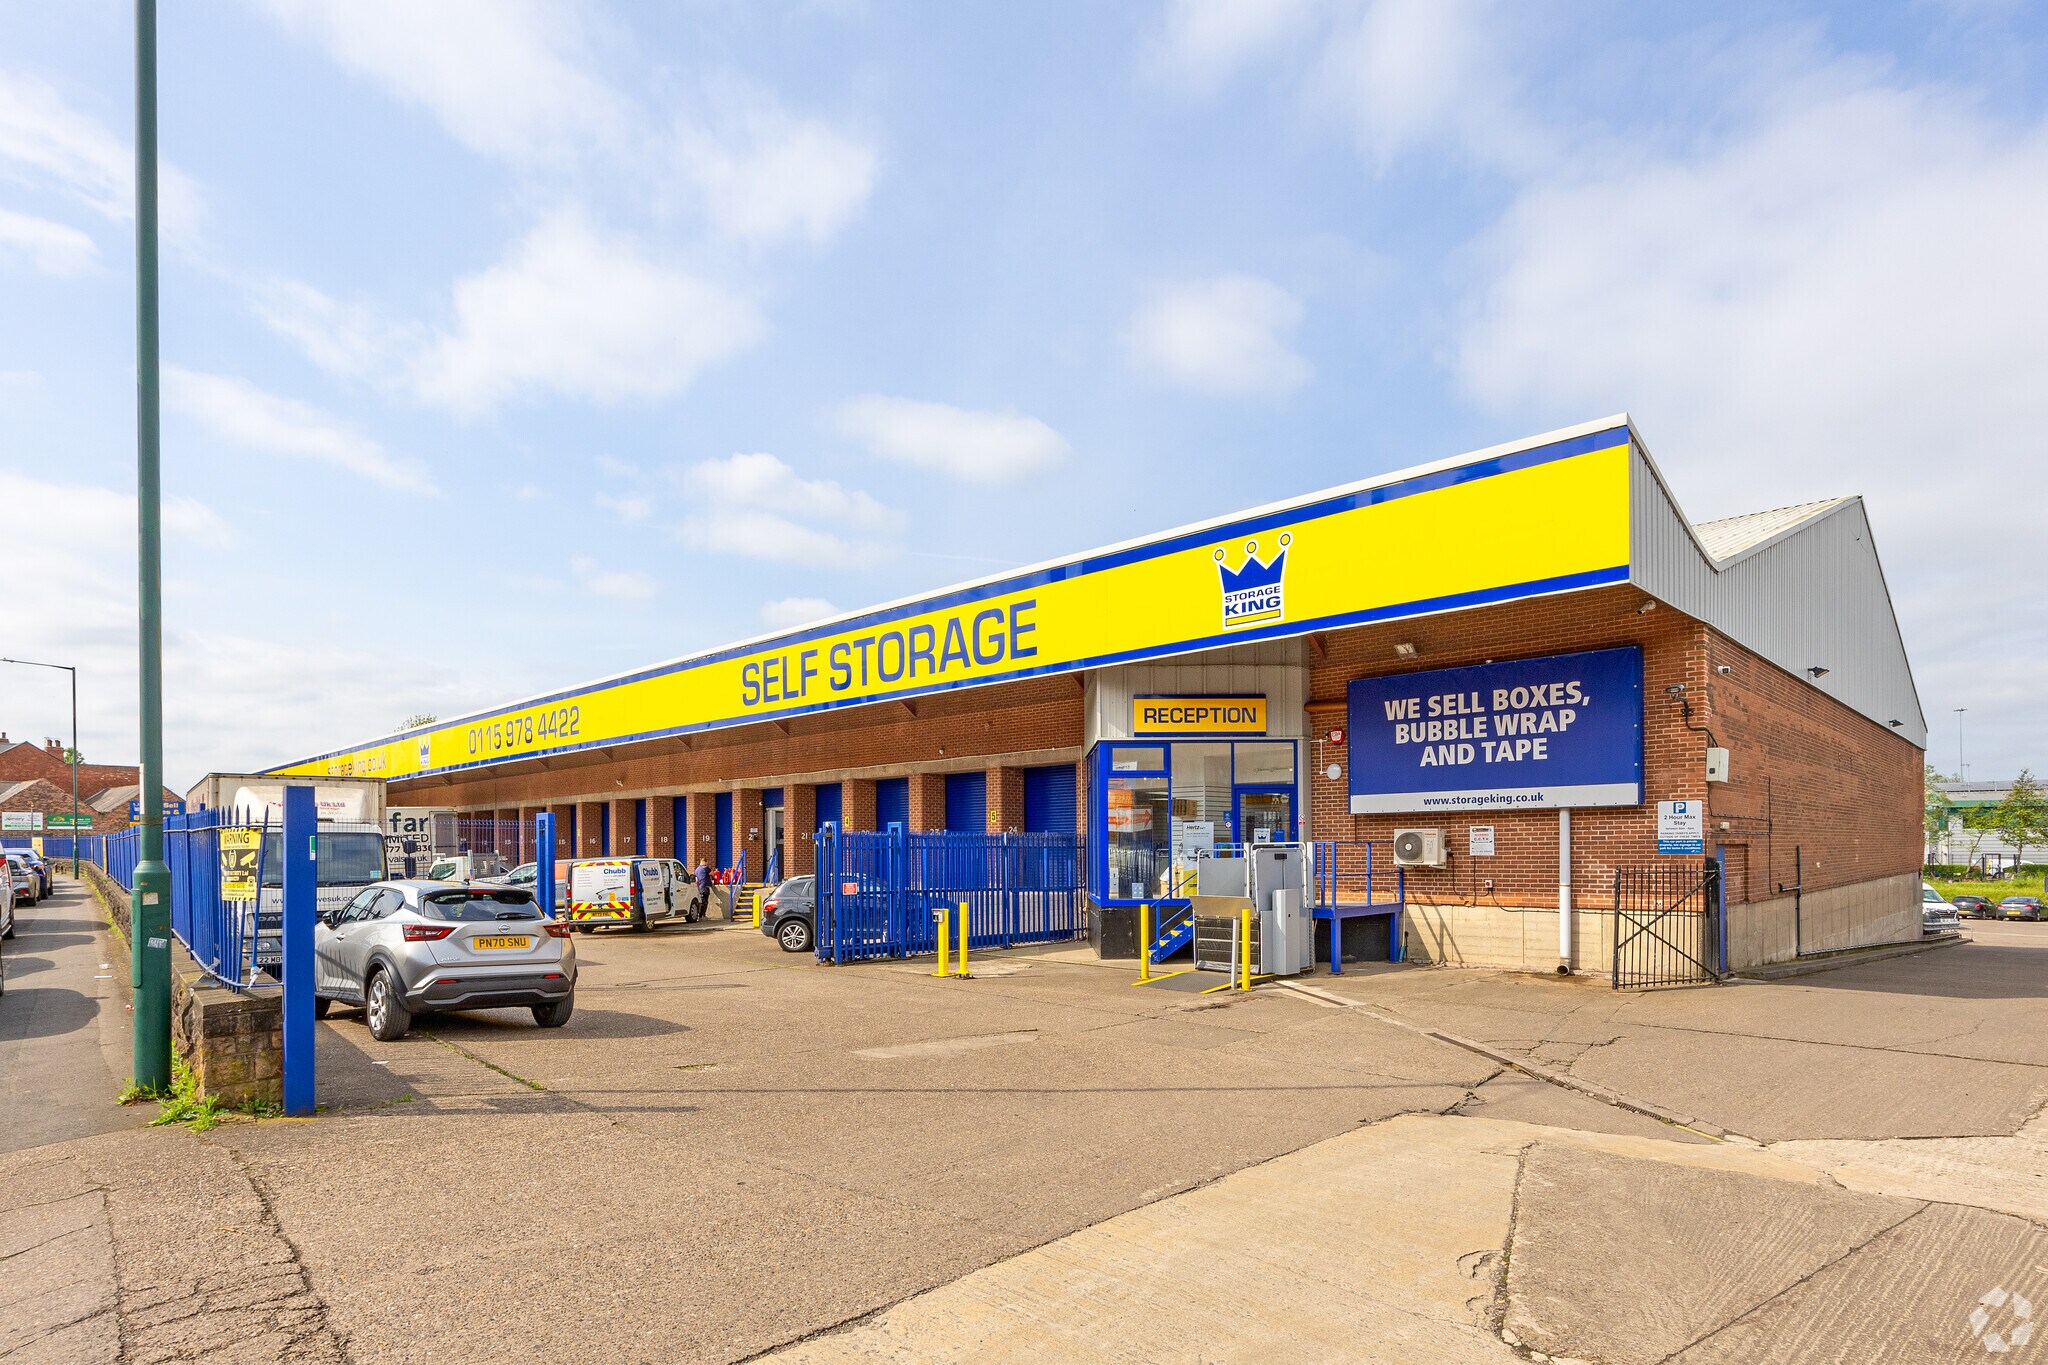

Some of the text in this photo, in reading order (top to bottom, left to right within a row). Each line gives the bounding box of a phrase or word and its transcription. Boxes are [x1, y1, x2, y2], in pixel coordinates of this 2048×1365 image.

[1224, 586, 1280, 603] STORAGE
[1225, 596, 1280, 616] KING
[742, 599, 1038, 706] SELF STORAGE
[1384, 681, 1590, 720] WE SELL BOXES,
[1143, 706, 1257, 724] RECEPTION
[468, 706, 580, 754] 0115 978 4422
[1395, 709, 1577, 744] BUBBLE WRAP
[1420, 738, 1548, 767] AND TAPE
[1423, 792, 1544, 806] www.storageking.co.uk
[991, 812, 996, 821] 5
[643, 868, 658, 876] Chubb
[480, 938, 526, 948] PN70 SNU
